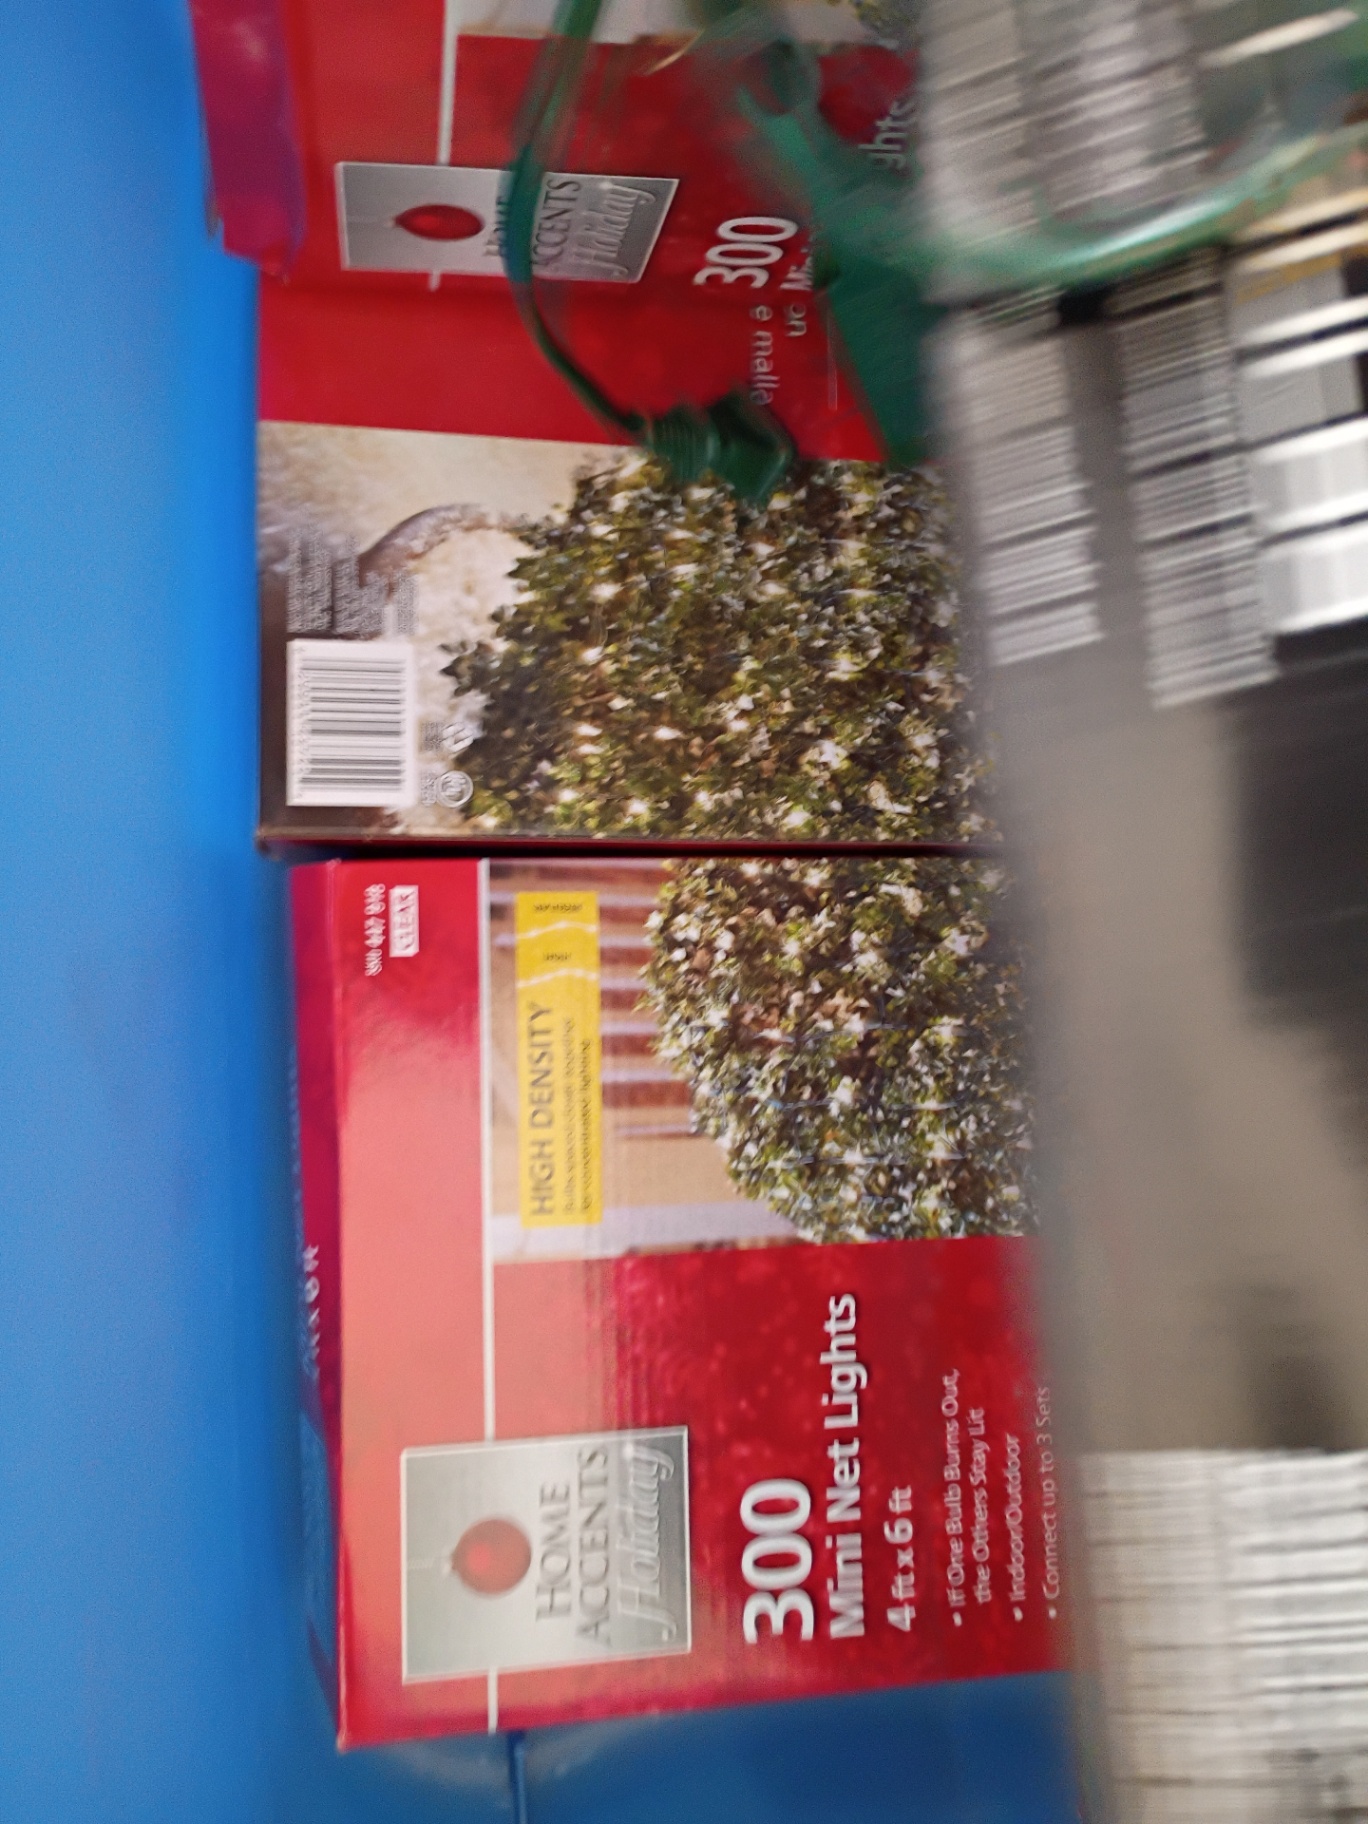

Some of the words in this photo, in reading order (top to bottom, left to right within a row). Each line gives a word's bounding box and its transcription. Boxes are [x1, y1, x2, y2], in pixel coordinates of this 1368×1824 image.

[572, 181, 656, 276] Holiday
[692, 216, 799, 288] 300
[395, 890, 415, 951] CLEAR
[528, 1001, 554, 1129] DENSITY
[530, 1139, 554, 1216] HIGH
[821, 1294, 868, 1430] Lights
[967, 1408, 985, 1435] Lit
[1036, 1387, 1052, 1427] Sets
[944, 1421, 961, 1480] Burns
[968, 1440, 989, 1485] Stay
[1037, 1433, 1052, 1445] 3
[1038, 1451, 1053, 1473] to
[825, 1438, 861, 1523] Net
[888, 1486, 912, 1514] ft
[945, 1483, 963, 1534] Bulb
[1042, 1480, 1058, 1506] up
[576, 1445, 611, 1647] ACCENTS
[615, 1441, 677, 1641] Holiday
[884, 1518, 913, 1544] 6
[970, 1488, 990, 1562] Others
[1005, 1433, 1026, 1601] Indoor/Outdoor
[535, 1483, 572, 1621] HOME
[740, 1478, 814, 1643] 300
[895, 1548, 914, 1569] x
[948, 1538, 965, 1586] One
[1041, 1512, 1060, 1600] Connect
[825, 1534, 865, 1639] Mini
[891, 1572, 915, 1601] ft
[950, 1586, 966, 1607] If
[974, 1566, 991, 1603] the
[886, 1605, 916, 1632] 4
